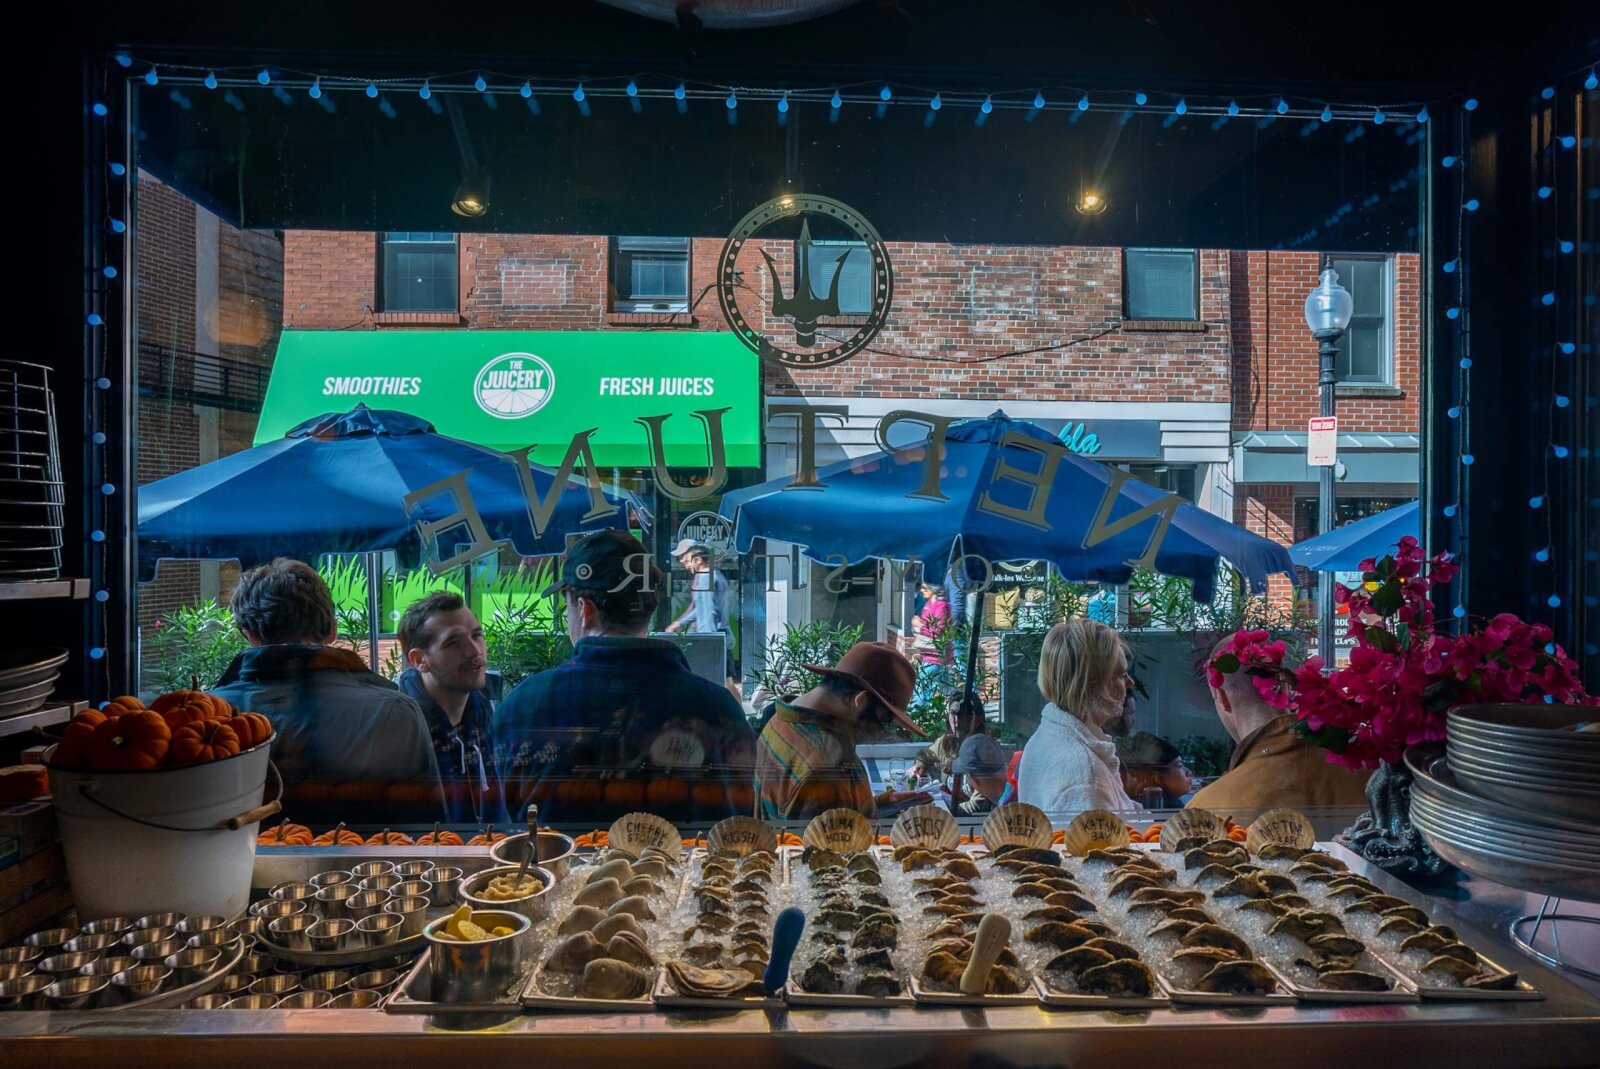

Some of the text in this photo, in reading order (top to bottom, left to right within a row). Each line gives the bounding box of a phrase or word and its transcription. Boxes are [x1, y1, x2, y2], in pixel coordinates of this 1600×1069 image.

[509, 360, 524, 370] THE
[322, 376, 422, 397] SMOOTHIES
[483, 369, 545, 391] JUICERY
[599, 376, 715, 397] FRESH JUICES
[699, 517, 709, 525] THE
[684, 525, 724, 541] JUICERY
[820, 817, 853, 832] KUMA
[1271, 835, 1298, 845] EARL
